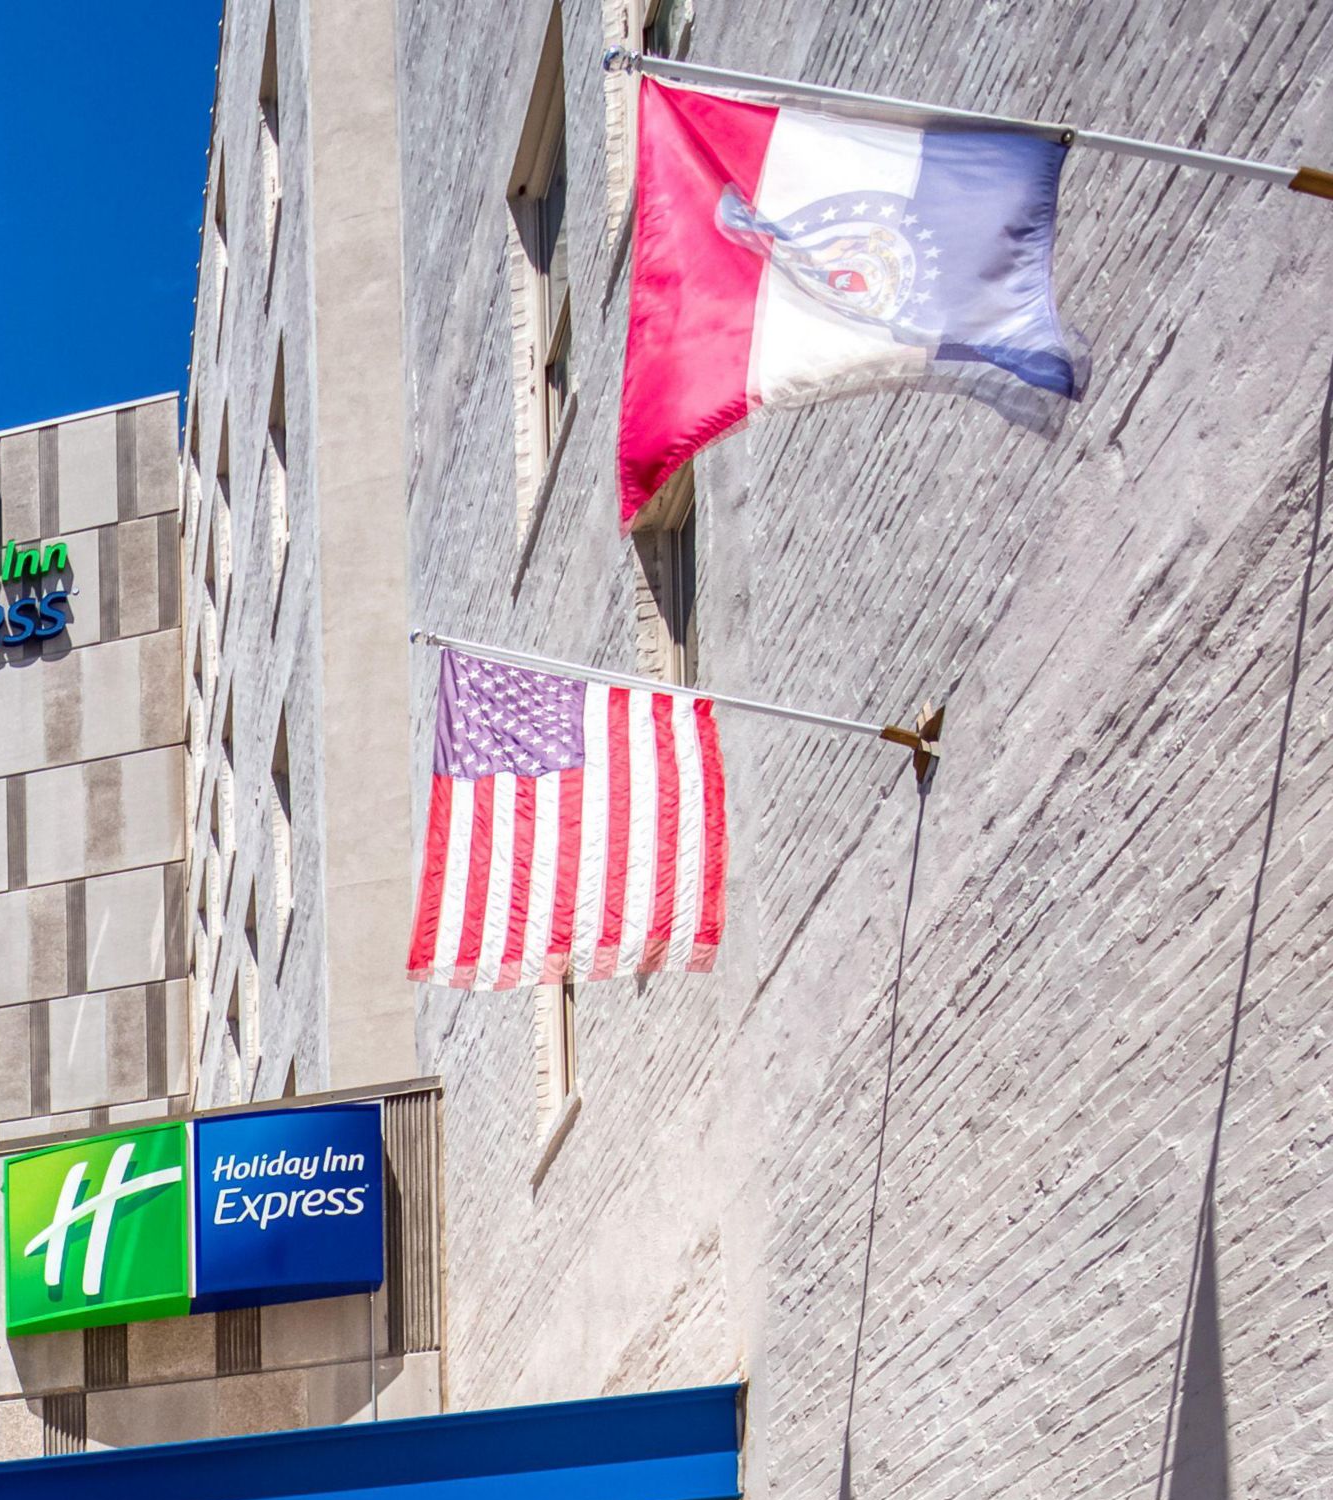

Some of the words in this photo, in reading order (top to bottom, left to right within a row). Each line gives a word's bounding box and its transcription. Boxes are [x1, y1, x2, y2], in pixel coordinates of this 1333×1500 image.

[1, 540, 69, 582] Inn
[212, 1150, 319, 1182] Holiday
[322, 1146, 365, 1173] Inn
[213, 1186, 366, 1231] Express
